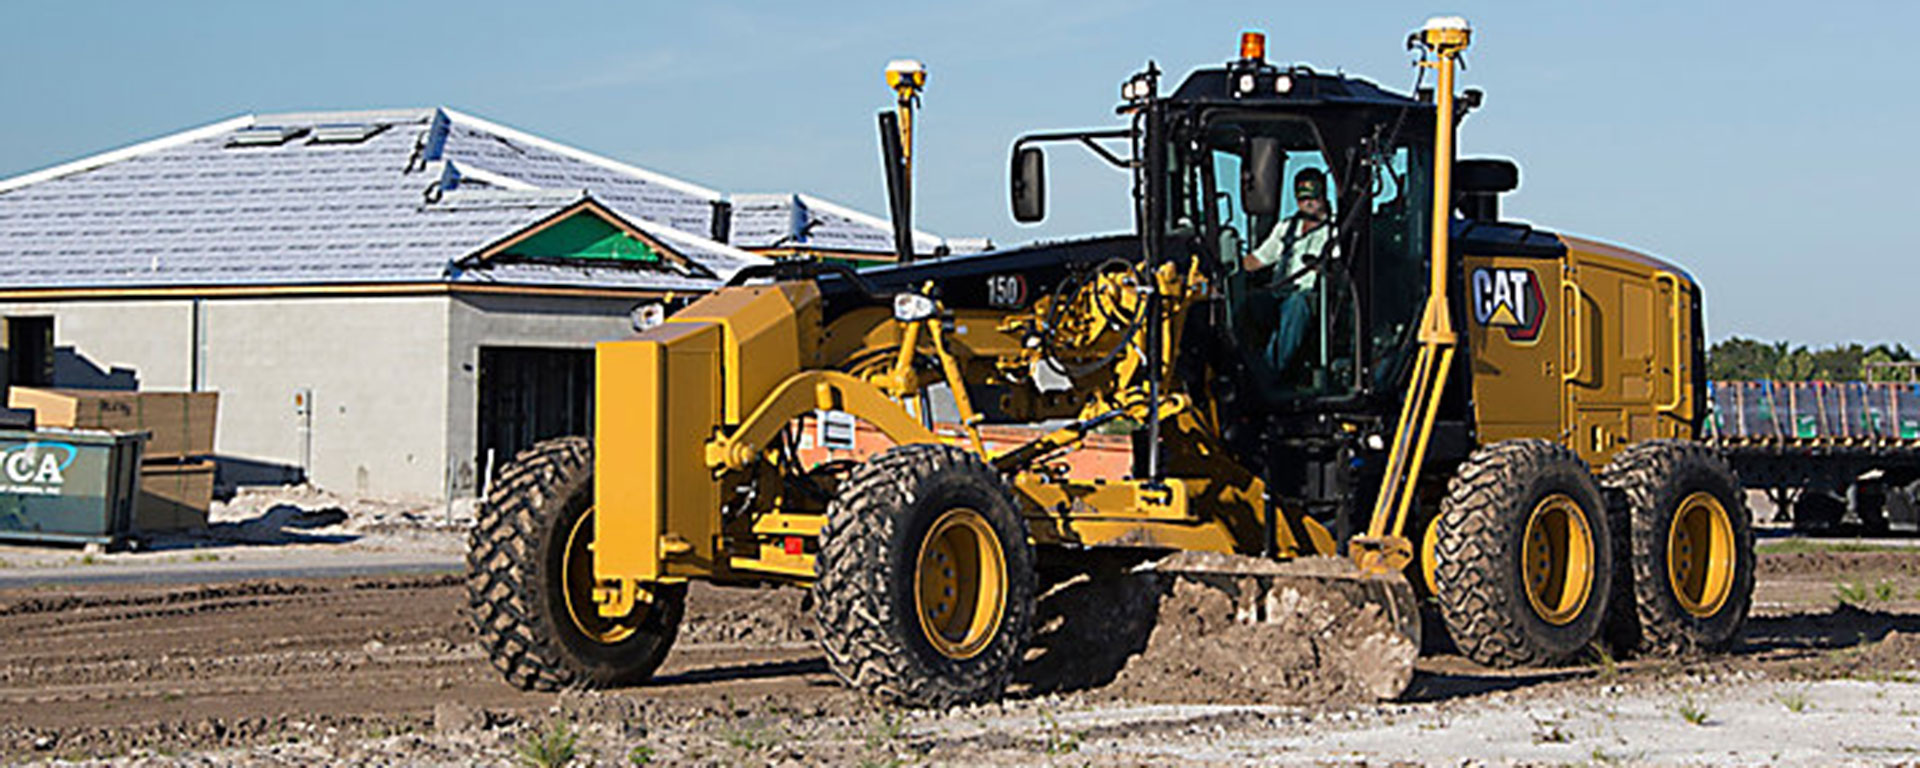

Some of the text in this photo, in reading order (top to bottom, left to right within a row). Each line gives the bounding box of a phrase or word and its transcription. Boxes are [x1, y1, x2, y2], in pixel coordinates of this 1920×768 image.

[986, 275, 1018, 306] 150
[1472, 268, 1528, 325] CAT
[0, 450, 64, 483] CA
